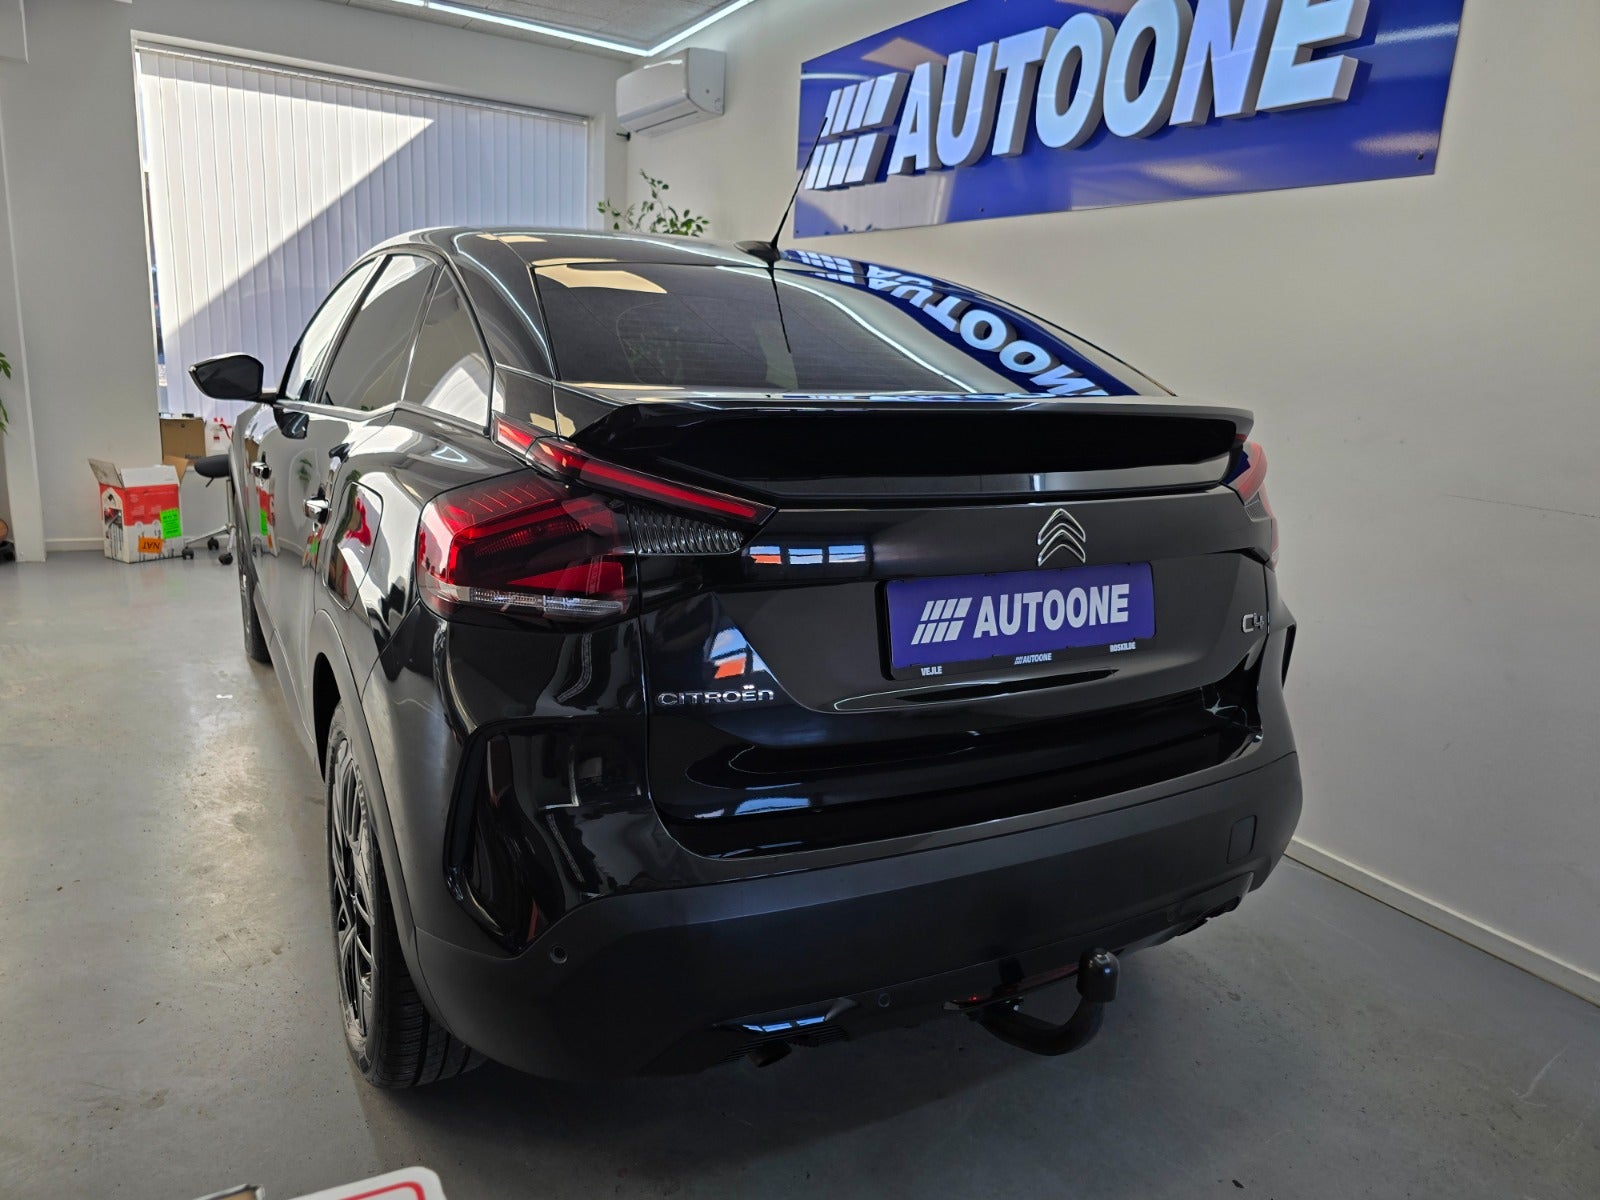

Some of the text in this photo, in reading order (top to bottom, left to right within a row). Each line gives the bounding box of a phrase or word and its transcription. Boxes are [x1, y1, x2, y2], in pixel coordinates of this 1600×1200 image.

[887, 0, 1364, 175] AUTOONE
[973, 584, 1129, 638] AUTOONE
[1242, 612, 1265, 633] C4
[1022, 652, 1052, 664] AUTOONE
[921, 666, 943, 676] VEJLE
